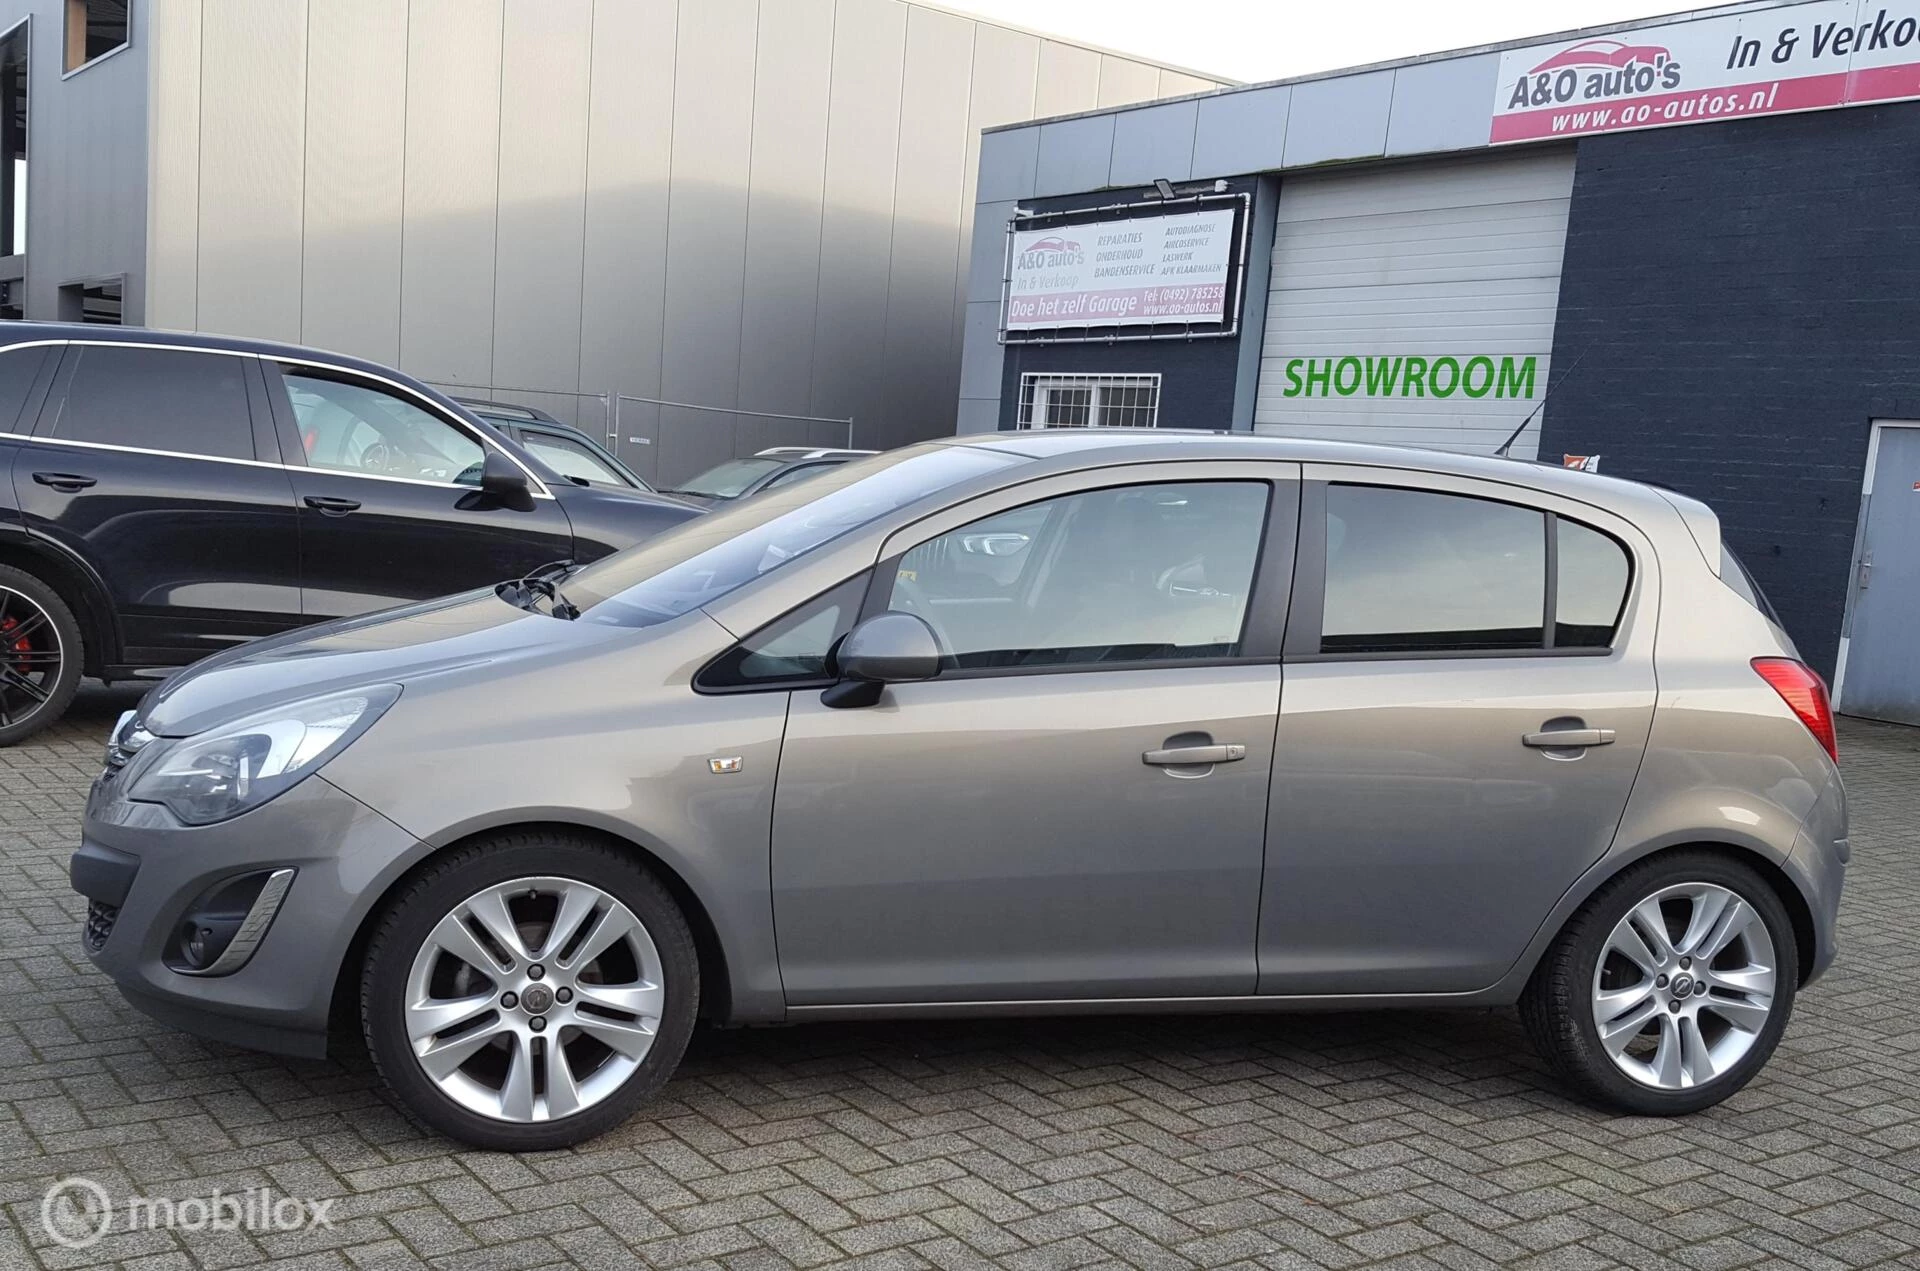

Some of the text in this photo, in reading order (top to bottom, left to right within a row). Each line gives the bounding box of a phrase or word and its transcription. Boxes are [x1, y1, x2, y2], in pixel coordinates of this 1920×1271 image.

[1726, 9, 1920, 70] In & Verko
[1508, 54, 1681, 109] A&O auto's
[1551, 81, 1779, 132] www.ao-autos.nl
[1165, 223, 1216, 236] AUTODIAGNOSE
[1097, 232, 1143, 246] REPARATIES
[1163, 237, 1209, 249] AIRCOSERVICE
[1017, 246, 1085, 270] A&O auto's
[1096, 248, 1143, 262] ONDERHOUD
[1162, 251, 1194, 262] LASWERK
[1094, 264, 1156, 278] BANDENSERVICE
[1161, 263, 1221, 275] APK KLAARMAKEN
[1039, 273, 1079, 289] Verkoop
[1159, 287, 1189, 304] (0492)
[1191, 286, 1224, 299] 785258
[1011, 294, 1137, 317] Doe het zelf Garage
[1143, 299, 1223, 315] www.ao-autos.nl
[1282, 355, 1538, 400] SHOWROOM
